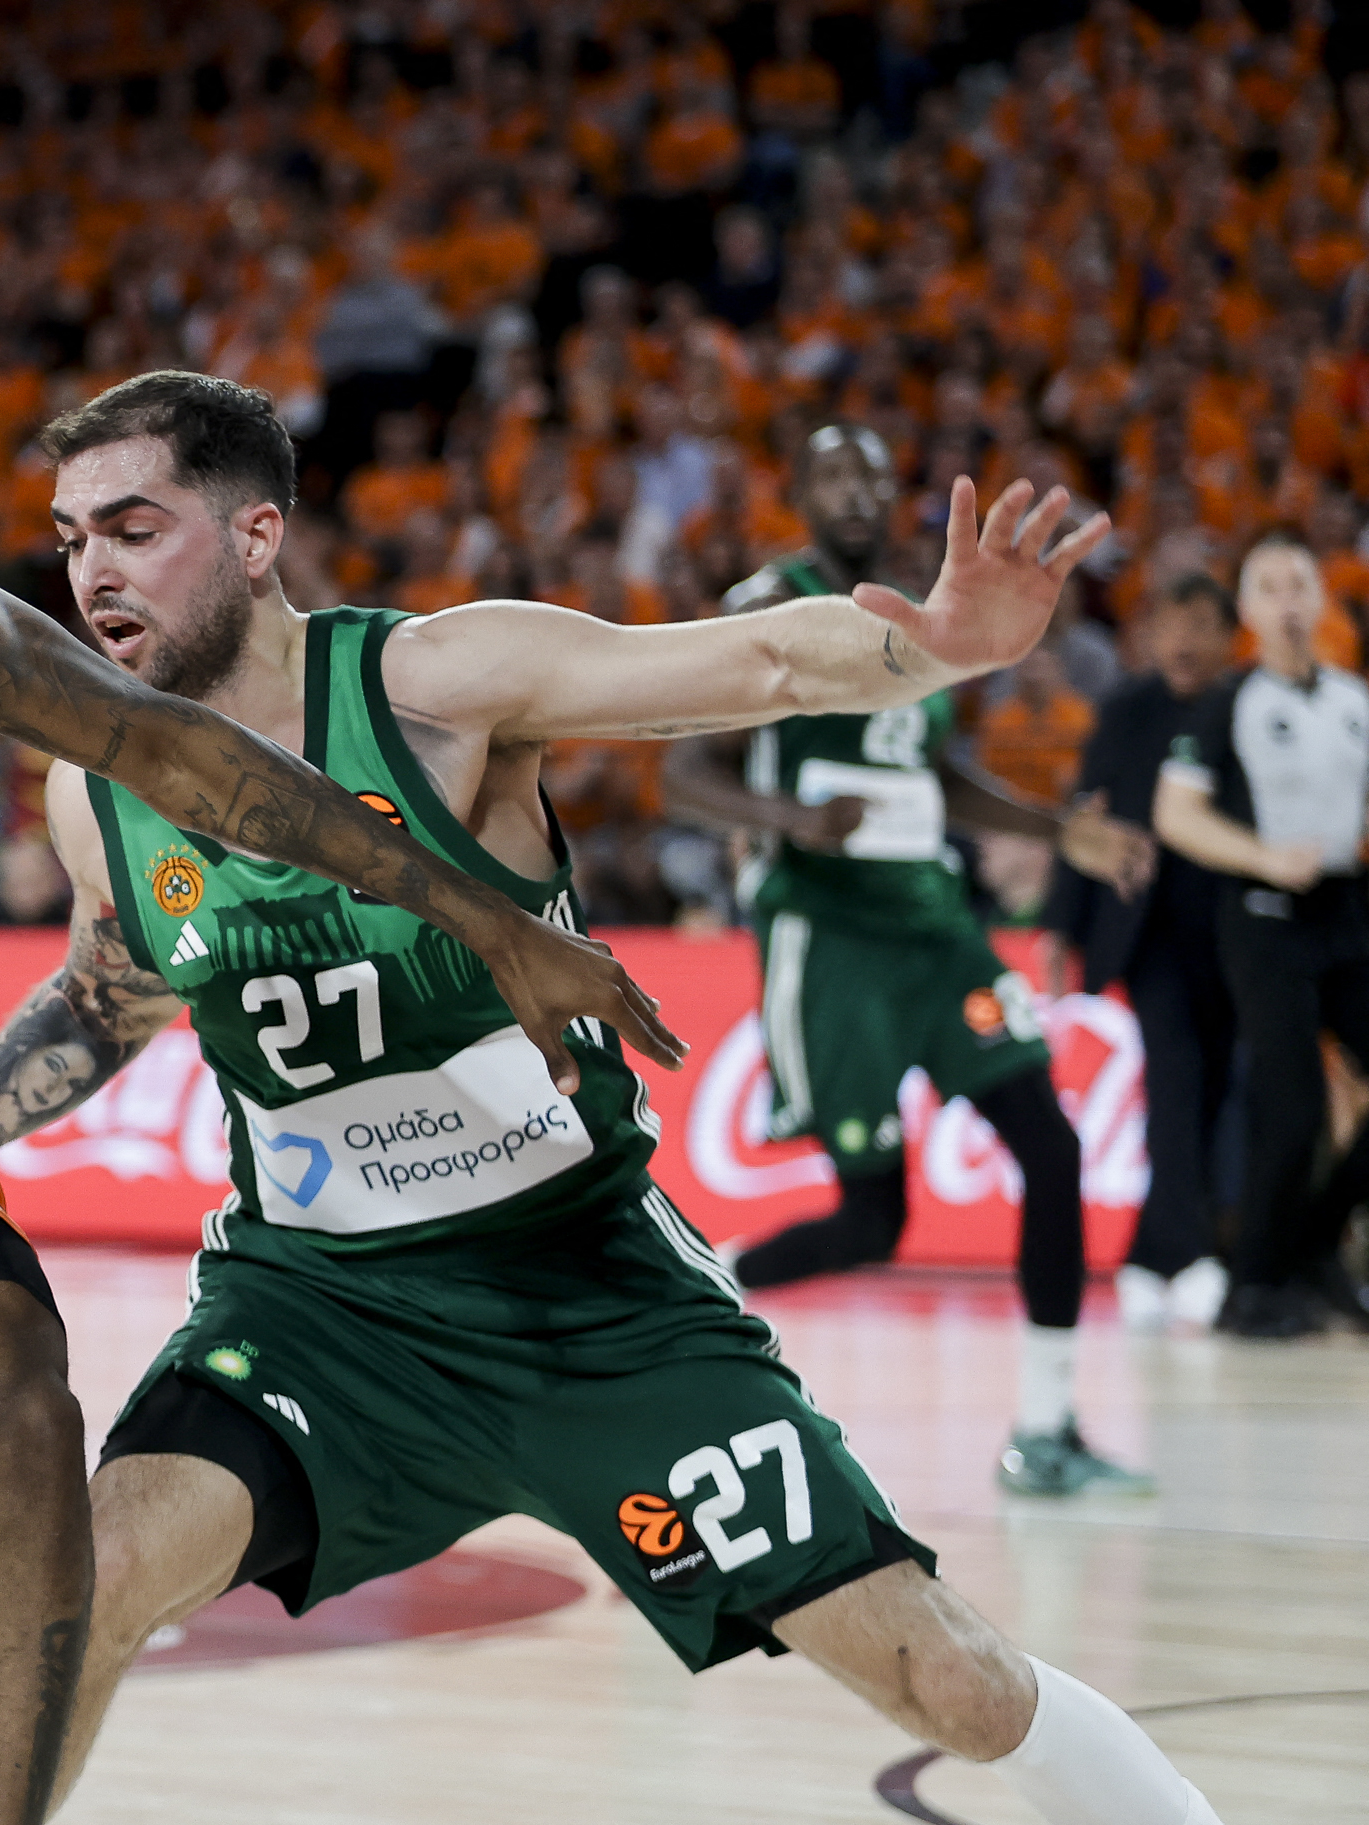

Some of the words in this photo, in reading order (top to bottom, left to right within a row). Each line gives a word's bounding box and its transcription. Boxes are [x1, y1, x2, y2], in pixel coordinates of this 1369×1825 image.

[241, 960, 385, 1090] 27
[343, 1107, 465, 1155] Ομάδα
[360, 1105, 569, 1194] Προσφοράς
[668, 1419, 812, 1573] 27
[649, 1549, 706, 1582] EuroLeague
